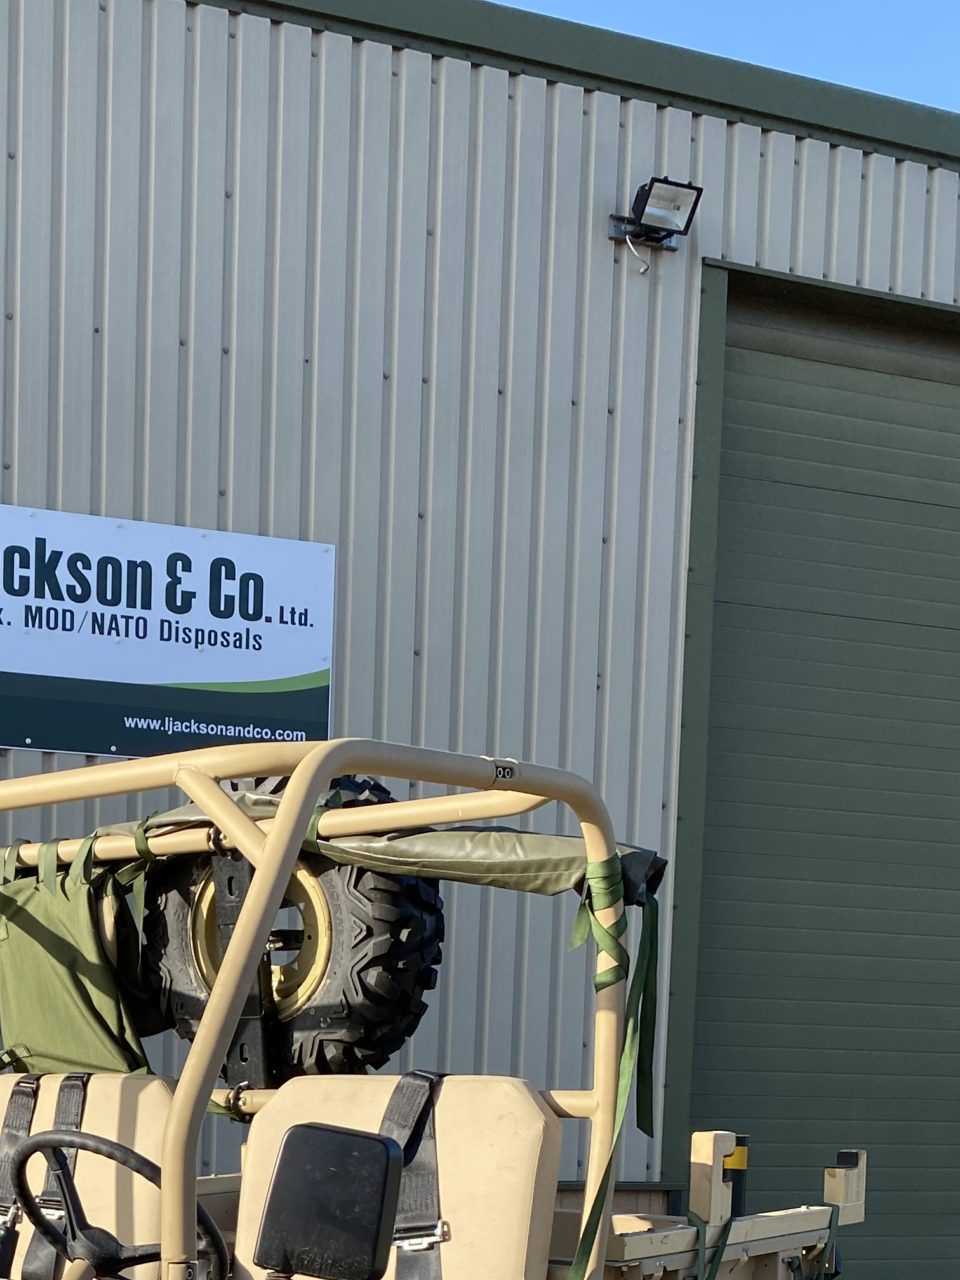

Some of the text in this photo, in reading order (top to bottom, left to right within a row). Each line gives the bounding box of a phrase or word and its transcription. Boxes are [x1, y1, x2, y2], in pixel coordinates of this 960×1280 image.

[165, 552, 197, 615] &
[208, 556, 273, 624] Co.
[278, 604, 315, 628] Ltd.
[24, 605, 149, 640] MOD/NATO
[159, 617, 264, 652] Disposals
[124, 716, 307, 743] www.ljacksonandco.com
